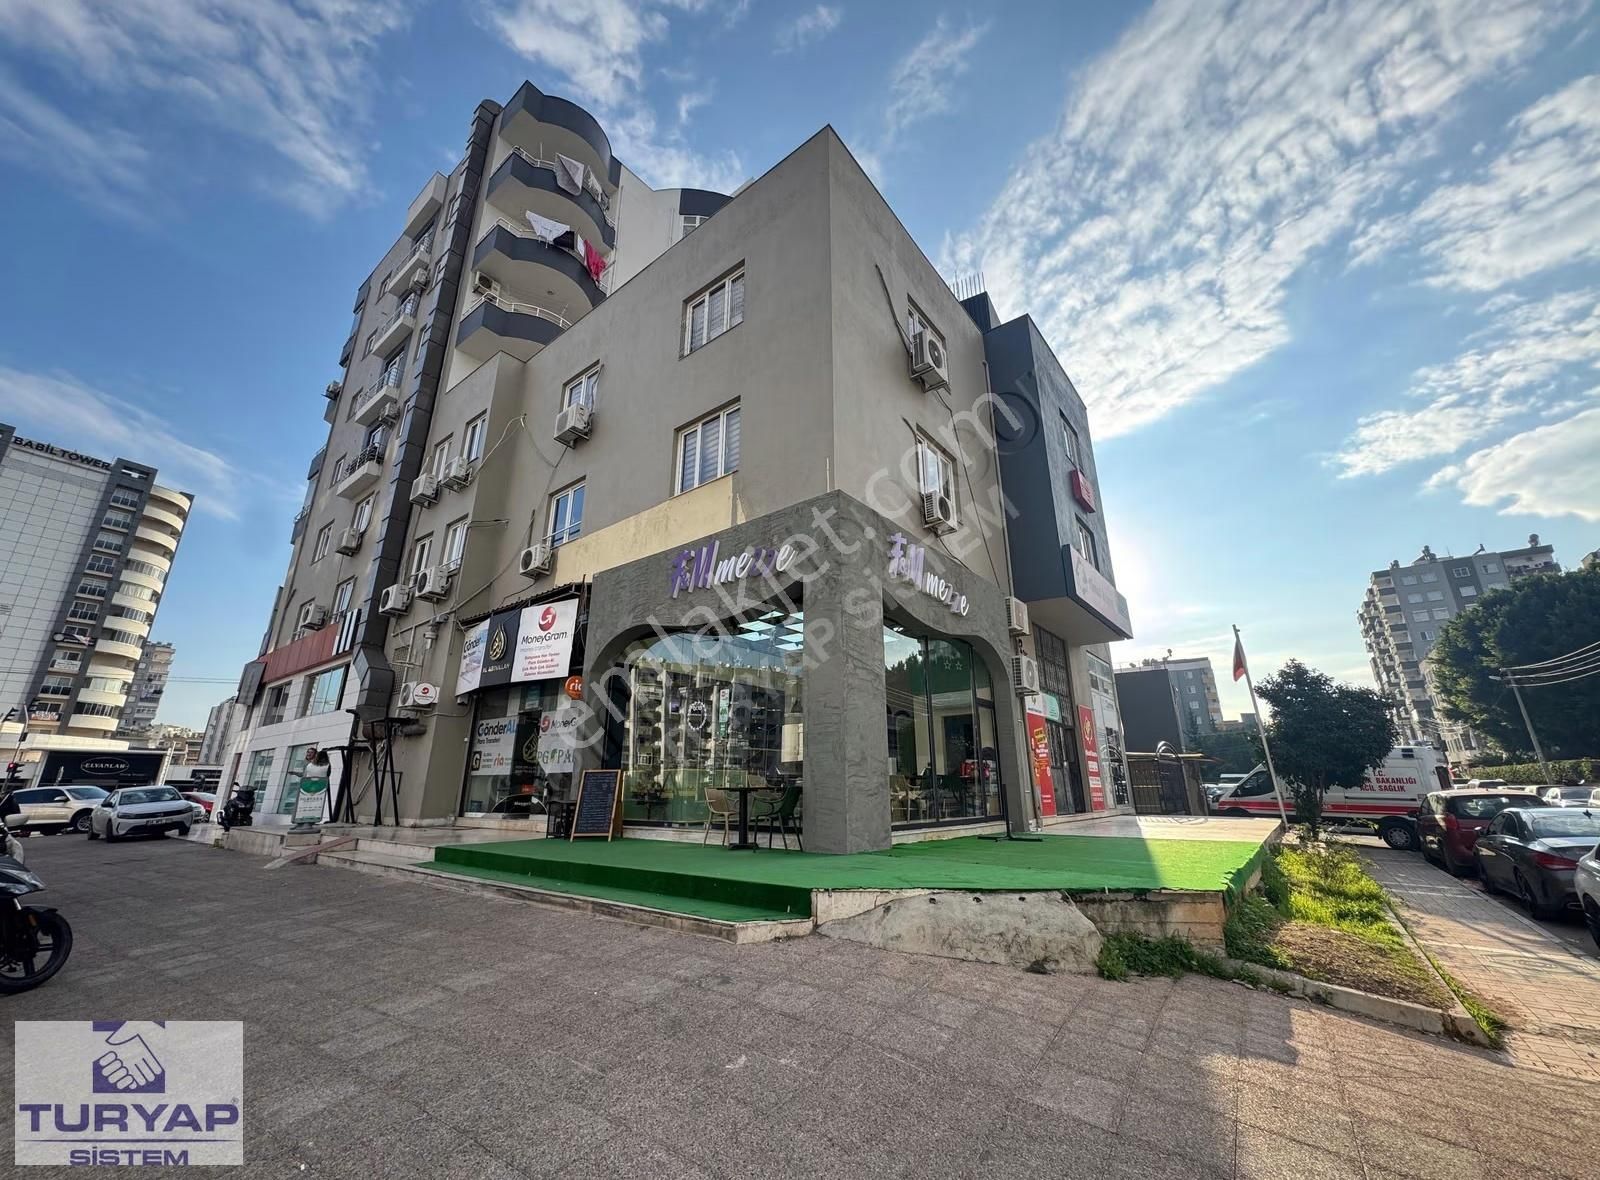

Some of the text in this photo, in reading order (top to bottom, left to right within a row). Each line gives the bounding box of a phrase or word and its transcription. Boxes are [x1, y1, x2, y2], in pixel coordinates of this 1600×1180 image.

[13, 436, 112, 471] BABİL TOWER
[520, 631, 568, 645] MoneyGram
[1375, 777, 1417, 785] BAKANLIĞI
[1378, 785, 1406, 793] SAĞLIK
